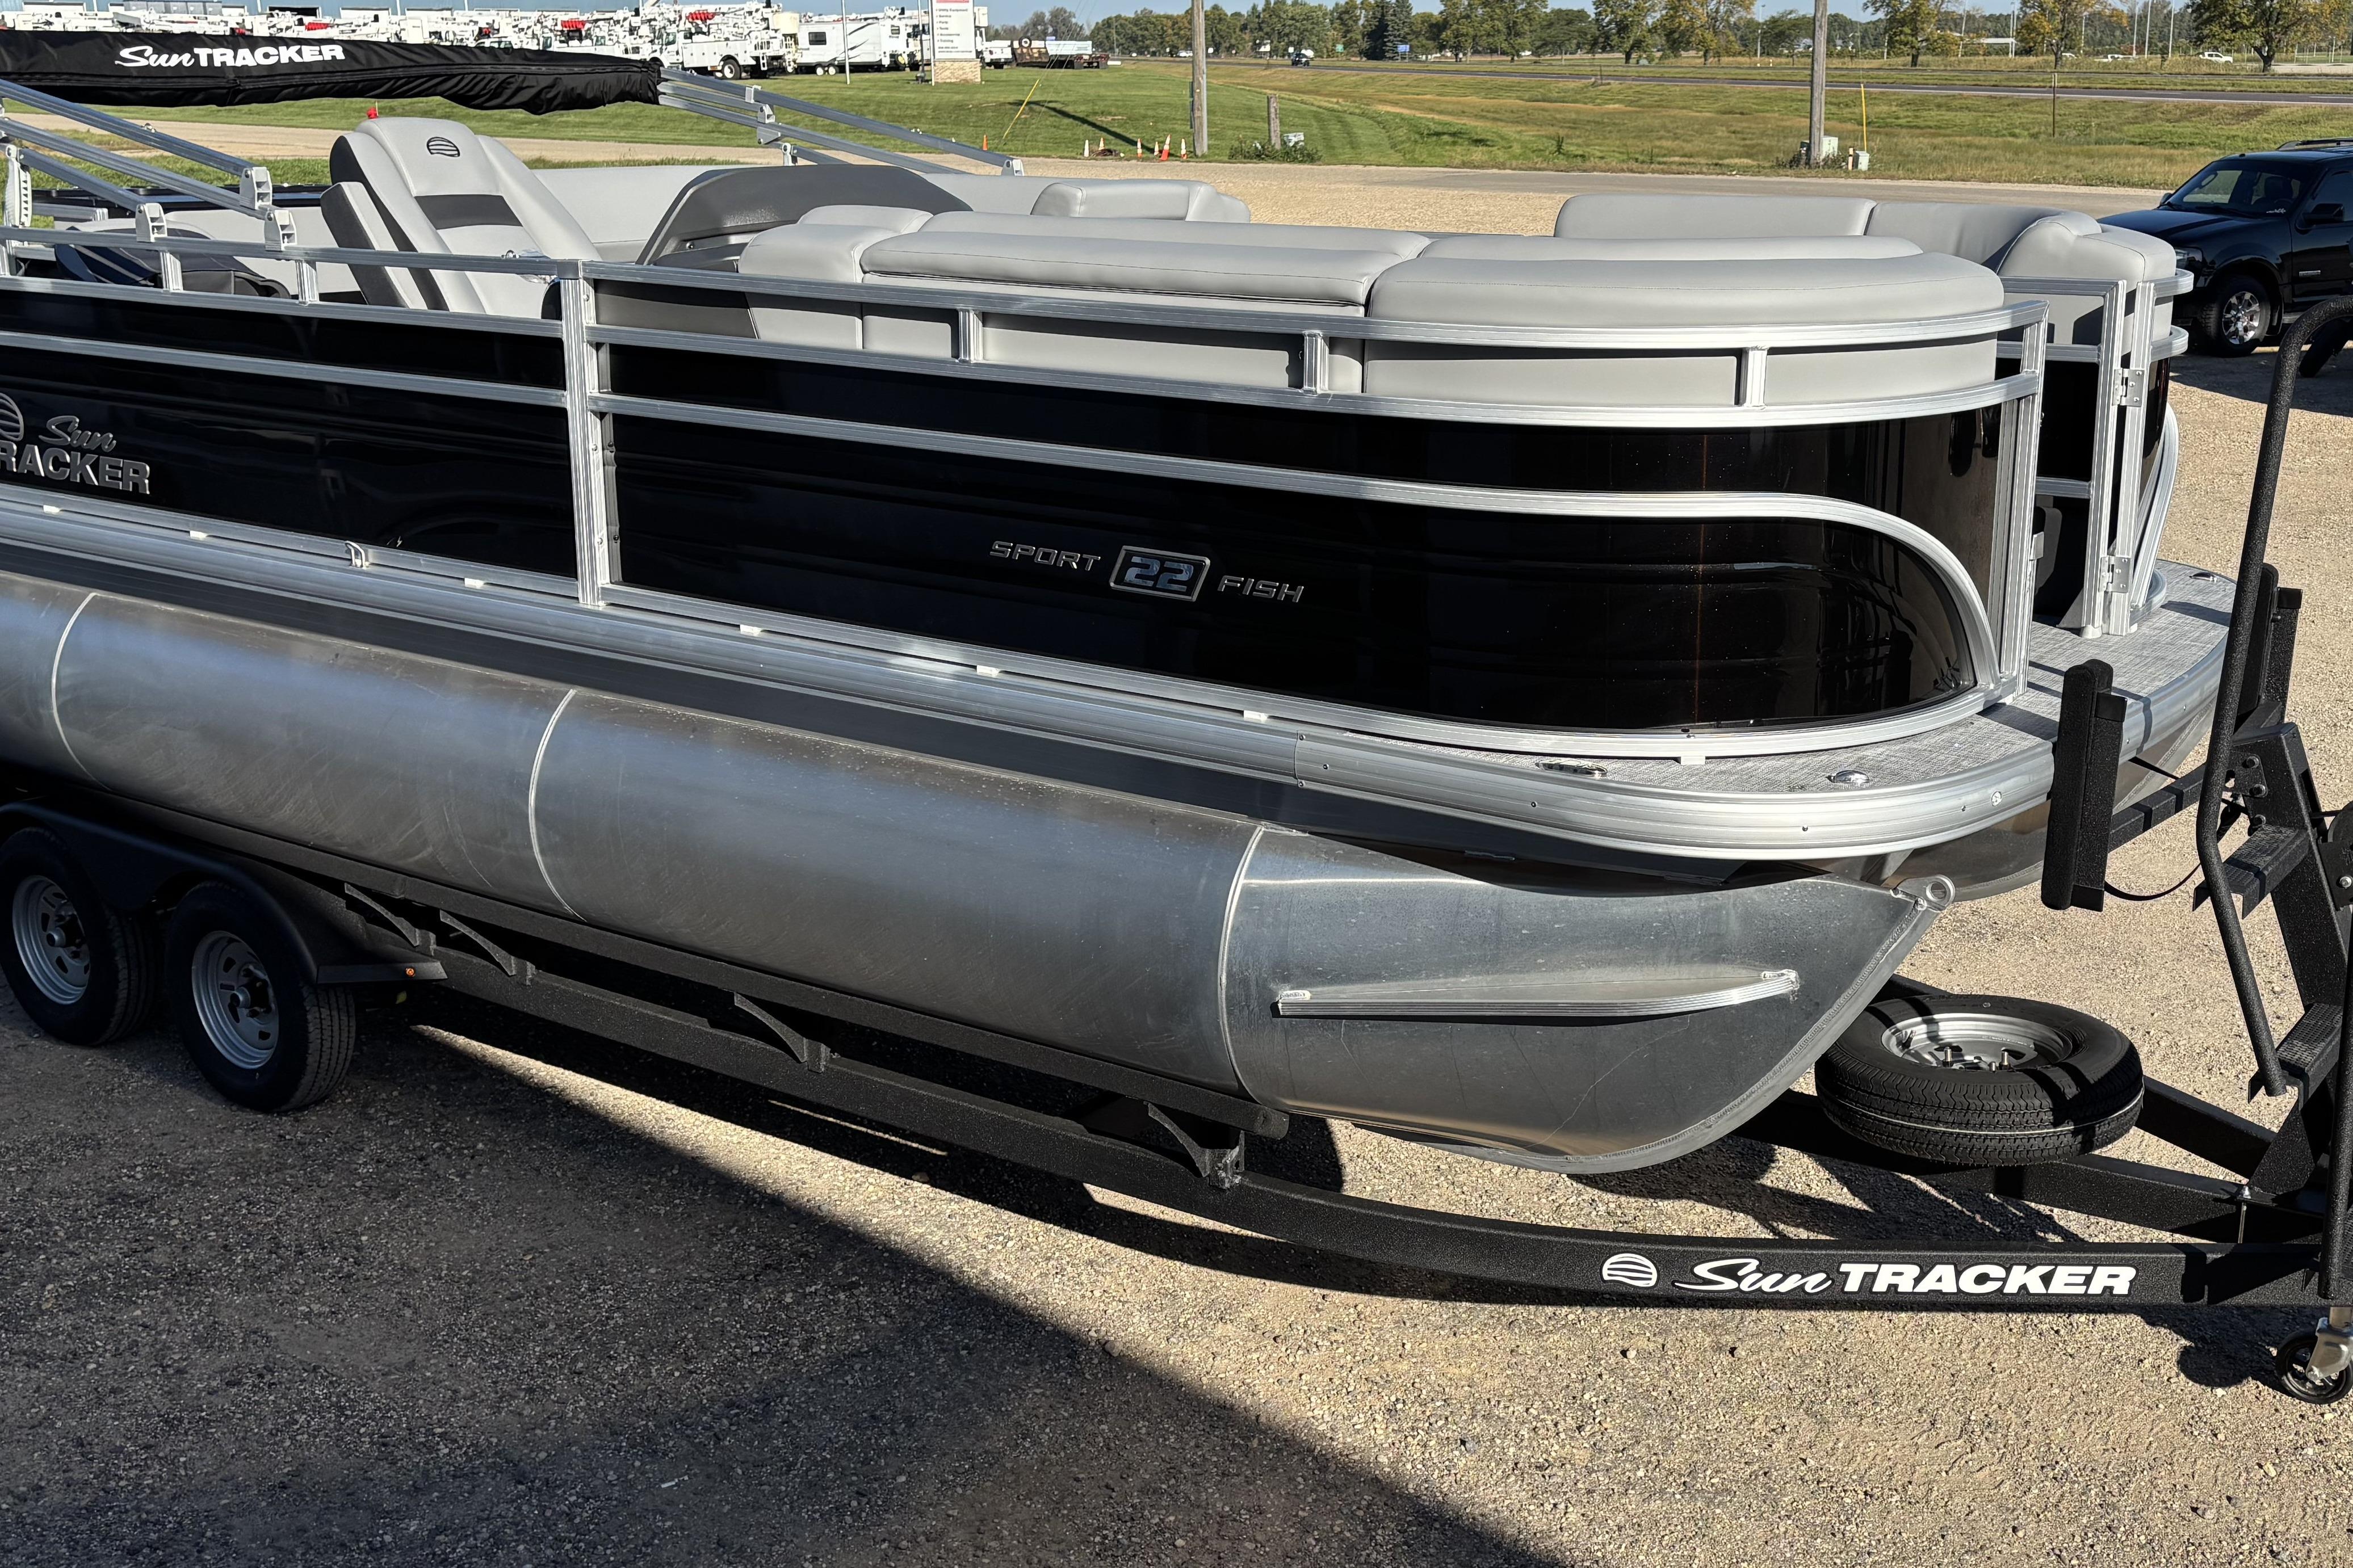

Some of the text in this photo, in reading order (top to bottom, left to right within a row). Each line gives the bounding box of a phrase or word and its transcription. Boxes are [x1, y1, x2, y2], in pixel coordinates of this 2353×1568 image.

[115, 44, 346, 67] Sun TRACKER
[38, 415, 117, 452] Sun
[989, 540, 1305, 603] SPORT 22 FISH
[1674, 1258, 2137, 1294] Sun TRACKER
